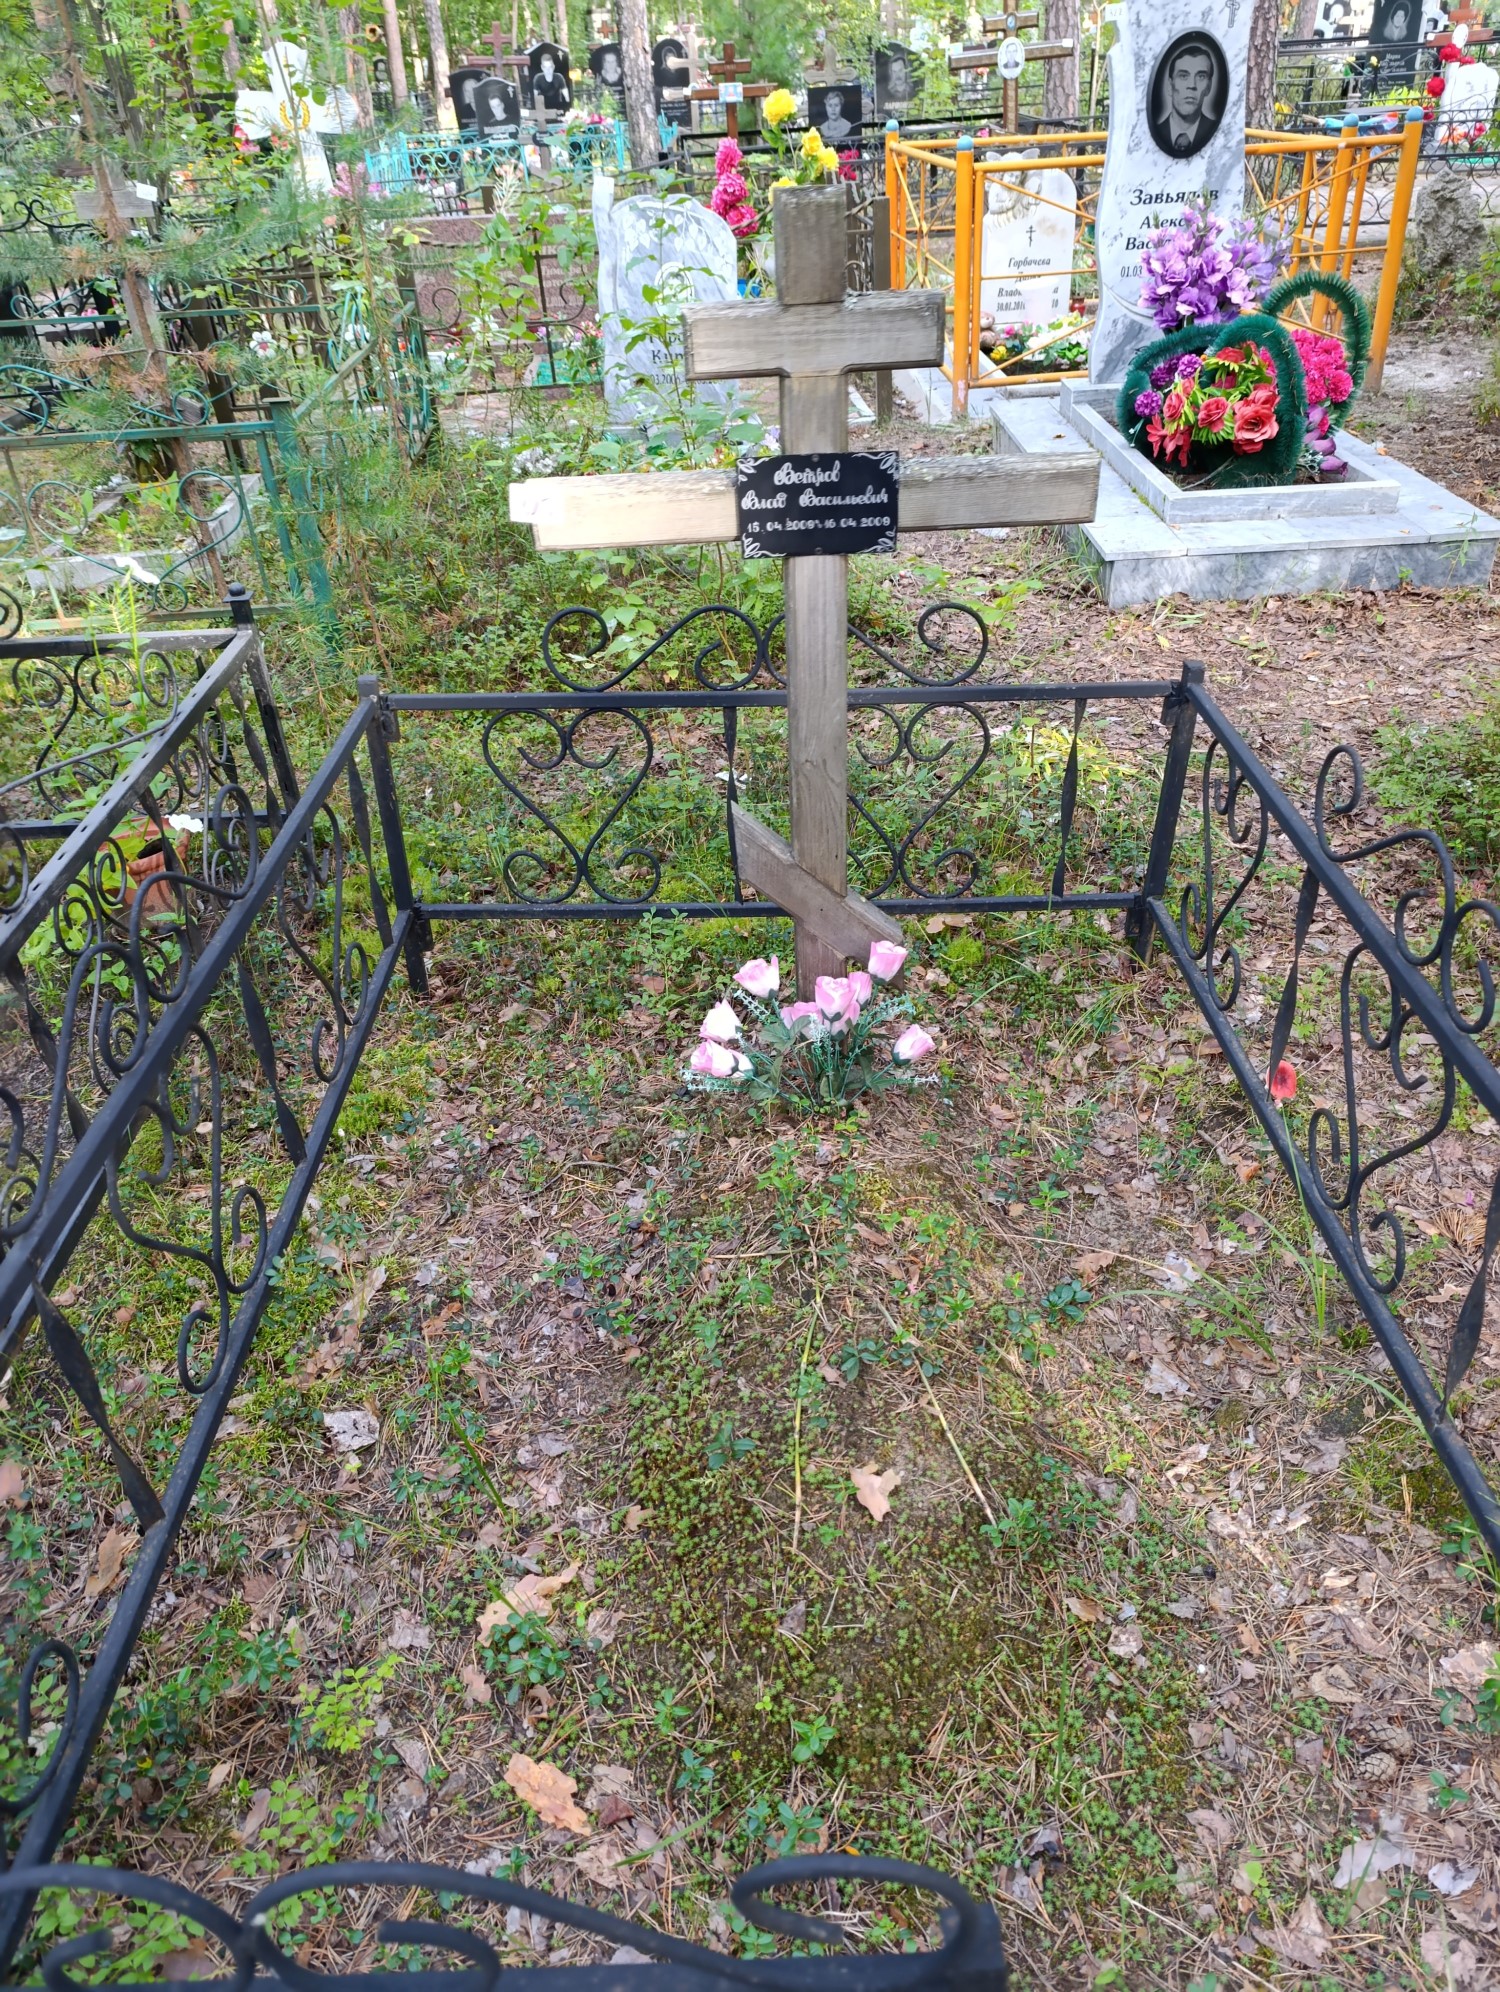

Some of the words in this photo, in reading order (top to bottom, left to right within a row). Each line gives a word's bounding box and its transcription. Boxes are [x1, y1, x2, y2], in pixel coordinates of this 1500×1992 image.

[1130, 188, 1219, 206] Завьялв
[773, 460, 841, 486] Ветров
[741, 490, 788, 510] Влад
[798, 485, 888, 507] Васильевич
